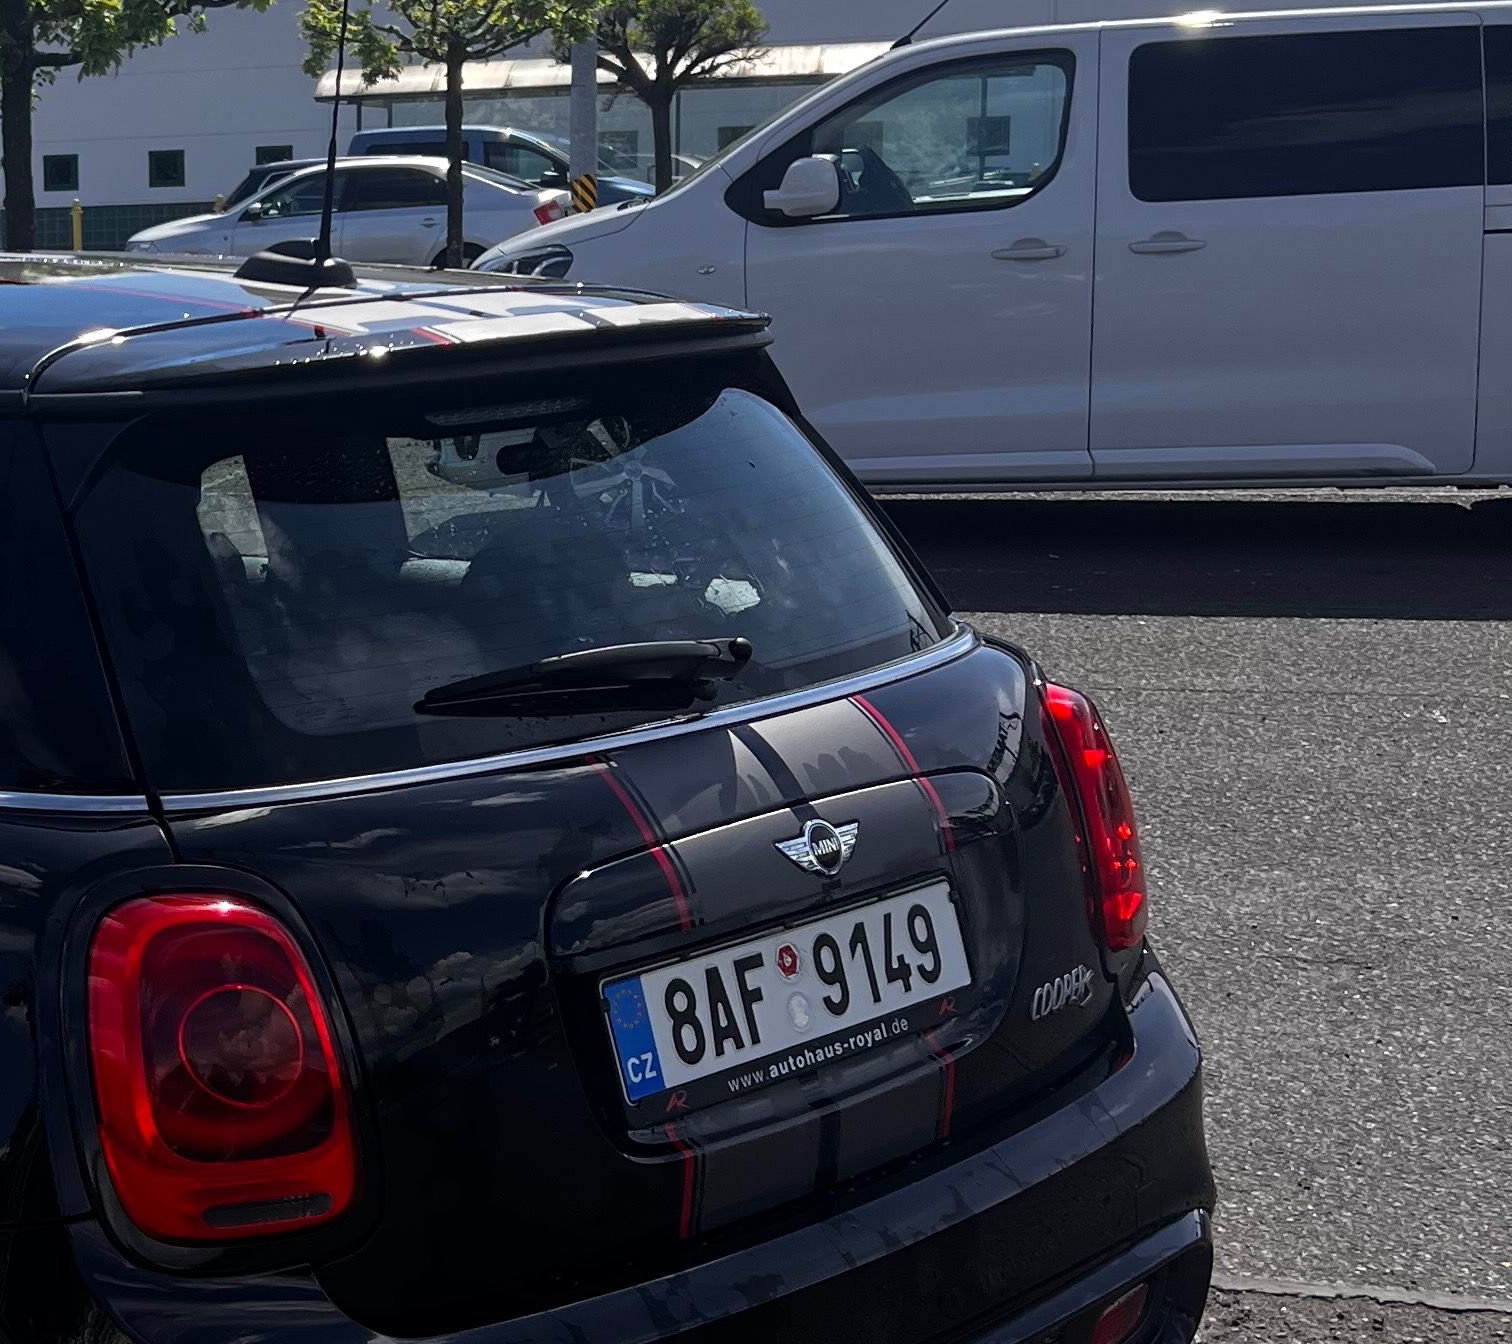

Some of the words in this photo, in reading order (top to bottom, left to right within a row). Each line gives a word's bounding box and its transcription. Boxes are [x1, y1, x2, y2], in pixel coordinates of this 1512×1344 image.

[811, 837, 839, 856] MINI
[664, 952, 765, 1066] 8AF
[812, 903, 942, 1017] 9149
[1031, 964, 1088, 1021] COOPER
[626, 1051, 658, 1084] CZ
[727, 1018, 910, 1093] www.autohaus-royal.de
